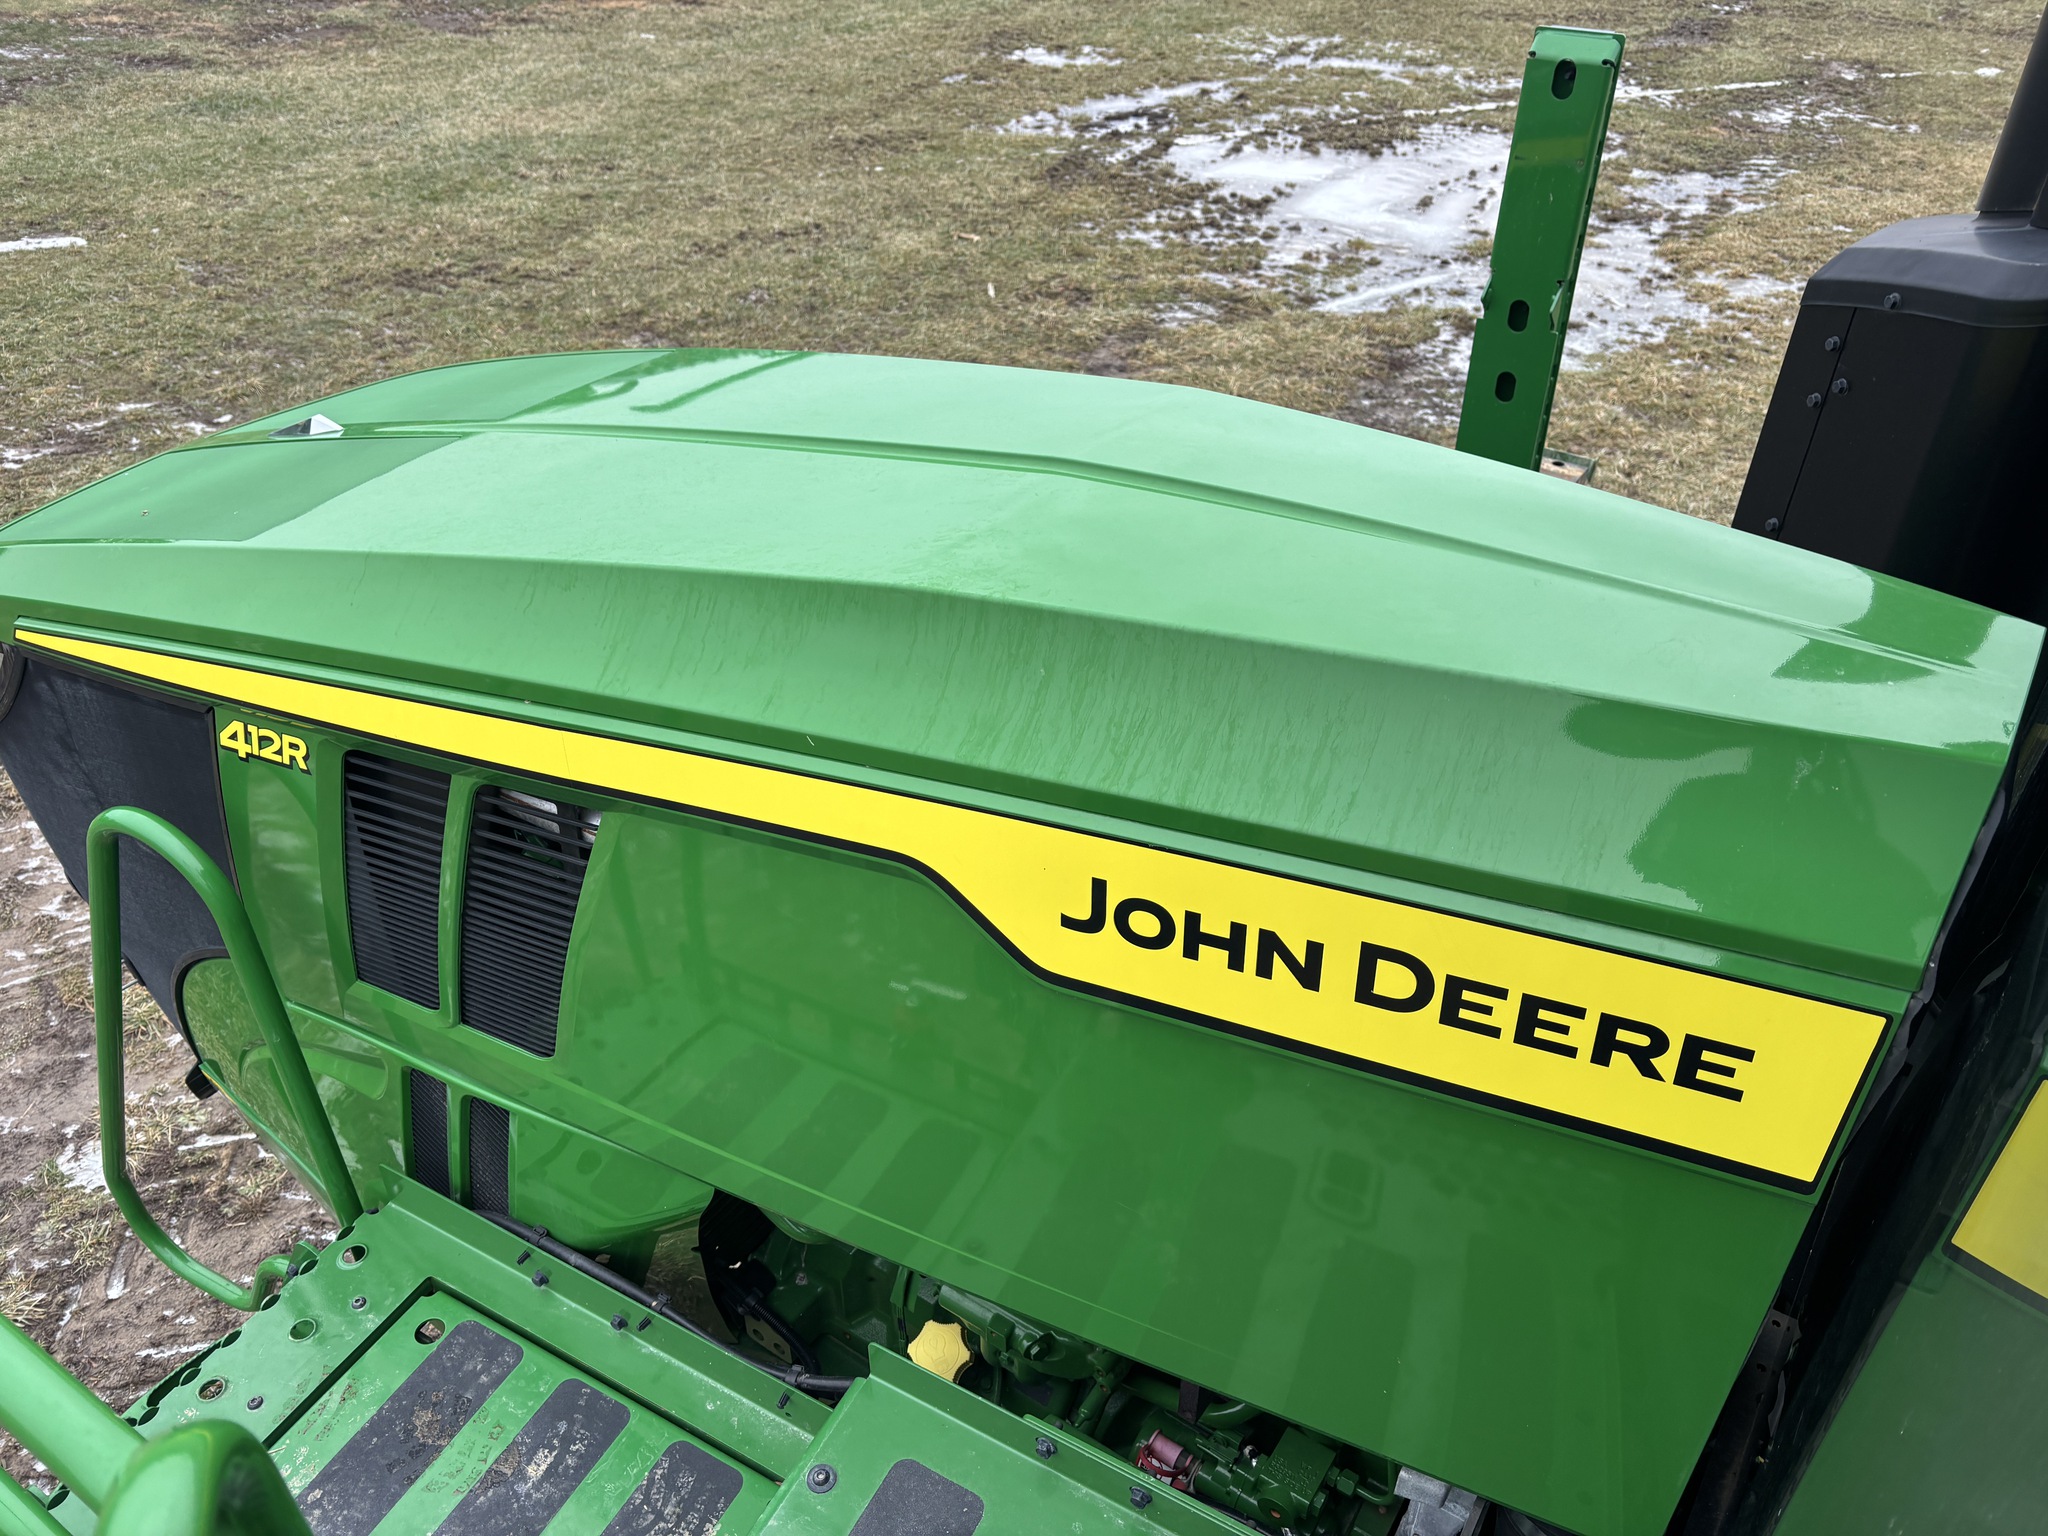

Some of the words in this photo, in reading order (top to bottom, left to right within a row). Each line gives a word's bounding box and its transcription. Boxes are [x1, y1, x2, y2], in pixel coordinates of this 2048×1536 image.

[219, 719, 310, 773] 412R
[1060, 877, 1325, 992] JOHN
[1354, 941, 1756, 1102] DEERE
